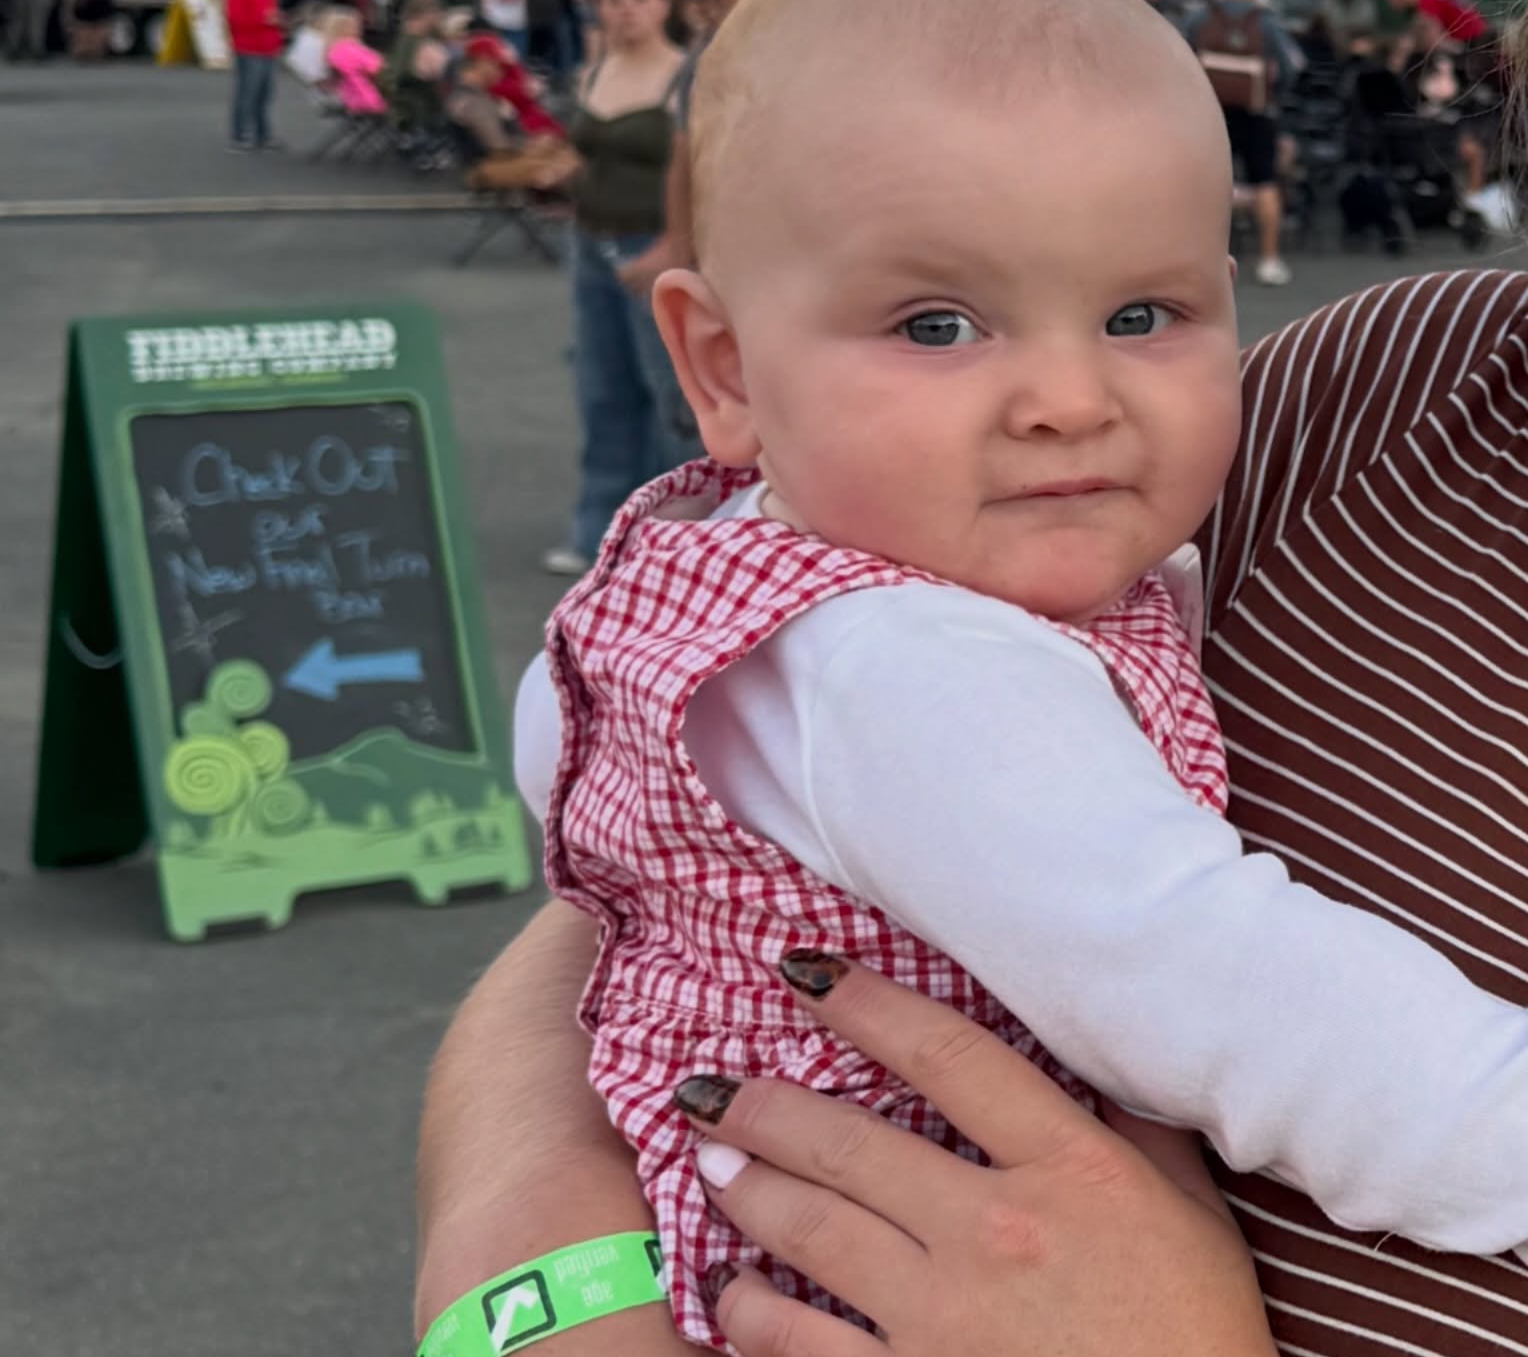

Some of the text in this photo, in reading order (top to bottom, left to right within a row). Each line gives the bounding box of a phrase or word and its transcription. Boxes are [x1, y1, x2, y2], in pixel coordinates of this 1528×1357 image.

[127, 318, 397, 367] FIDDLEHEAD
[182, 443, 304, 506] Check
[168, 546, 257, 595] New
[552, 1244, 620, 1283] verified
